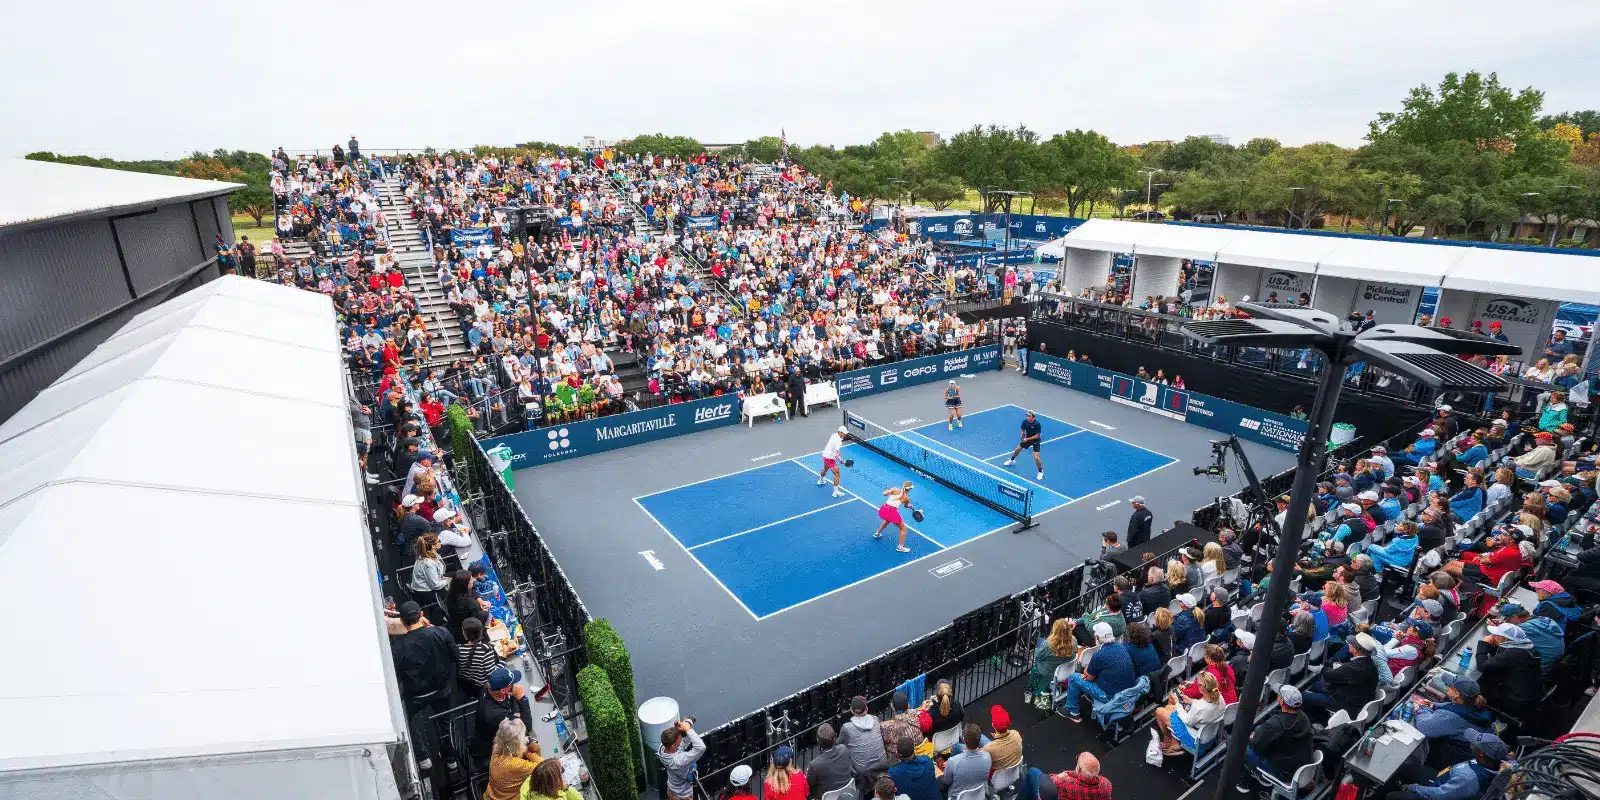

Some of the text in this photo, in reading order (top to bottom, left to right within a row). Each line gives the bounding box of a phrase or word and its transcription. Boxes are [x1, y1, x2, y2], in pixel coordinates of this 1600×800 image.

[454, 233, 488, 241] Southwest
[1268, 276, 1290, 286] USA
[1265, 284, 1301, 293] PICKLEBALL
[1366, 284, 1411, 297] Pickleball
[1372, 293, 1409, 304] Central
[1486, 304, 1519, 316] USA
[1481, 312, 1536, 325] PICKLEBALL
[944, 354, 969, 366] Pickleball
[903, 364, 937, 378] OOFOS
[695, 403, 732, 420] Hertz
[596, 413, 677, 441] MARGARITAVILLE
